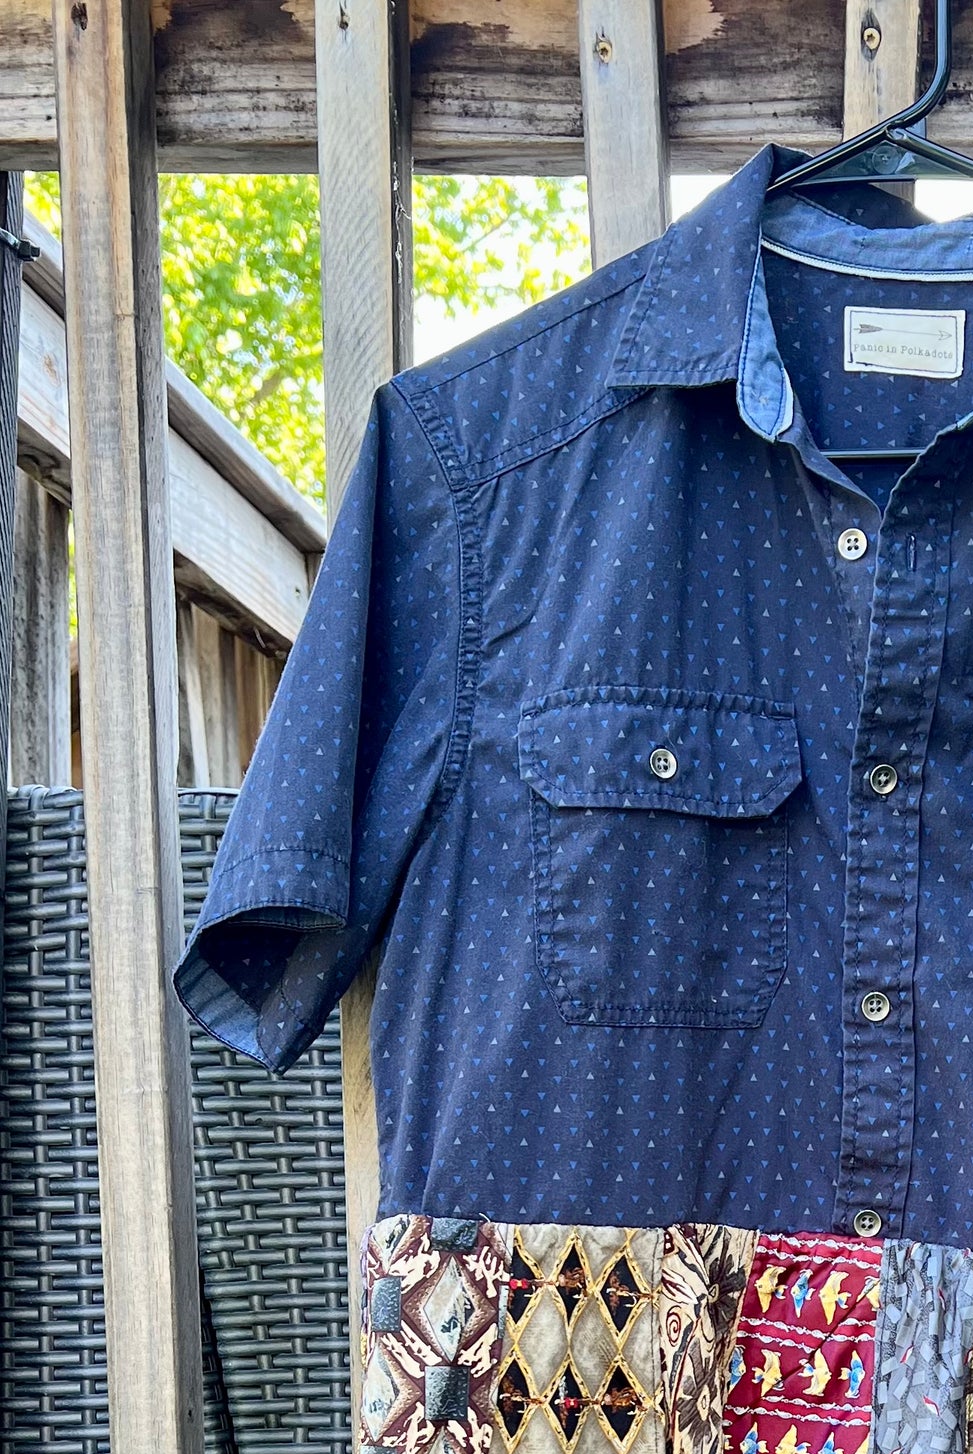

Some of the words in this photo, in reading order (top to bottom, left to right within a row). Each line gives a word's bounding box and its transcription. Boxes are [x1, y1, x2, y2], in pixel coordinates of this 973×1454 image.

[853, 343, 884, 352] Panic
[886, 344, 897, 353] in
[900, 345, 953, 359] Polkadots
